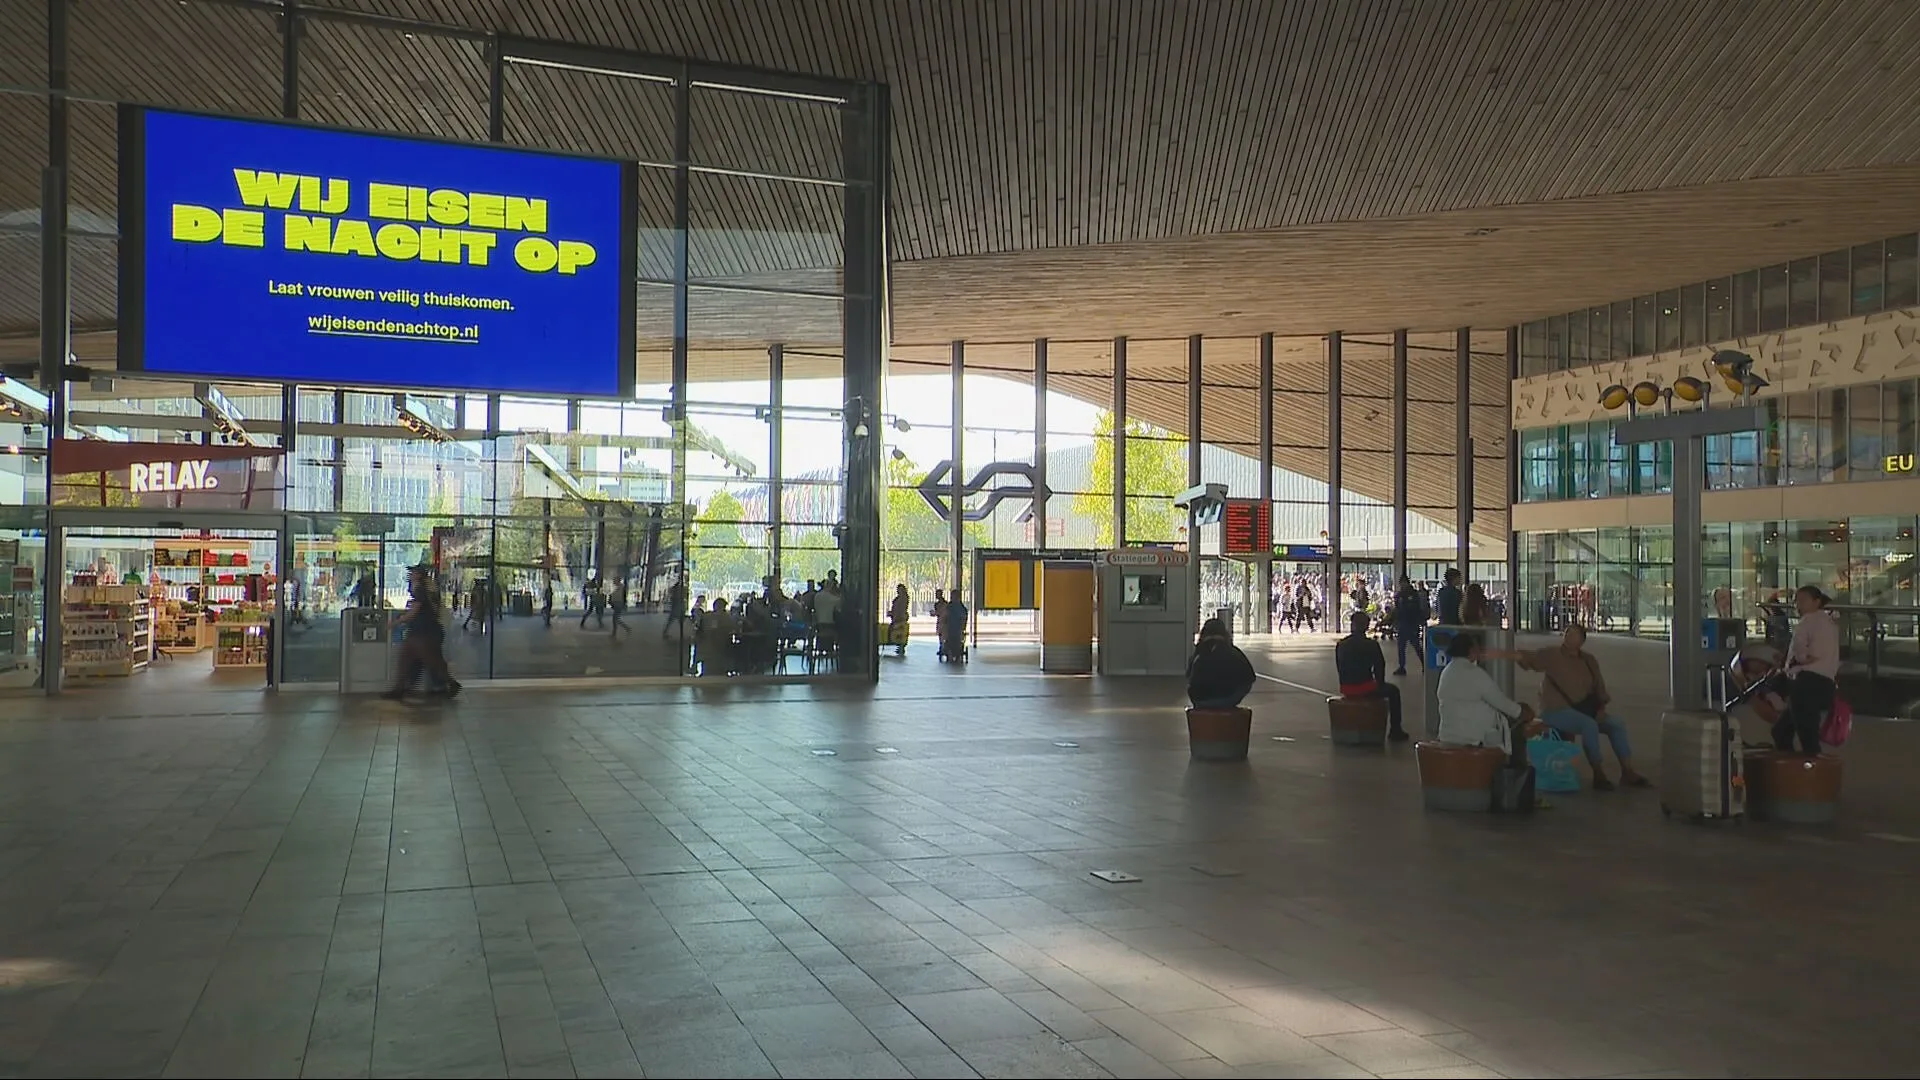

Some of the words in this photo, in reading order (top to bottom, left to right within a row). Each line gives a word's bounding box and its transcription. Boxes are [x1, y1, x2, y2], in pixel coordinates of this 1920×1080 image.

[233, 168, 349, 215] WIJ
[368, 182, 548, 233] EISEN
[171, 203, 265, 248] DE
[284, 213, 497, 266] NACHT
[513, 236, 597, 275] OP
[268, 280, 304, 296] Laat
[307, 285, 375, 301] vrouwen
[378, 289, 420, 308] veilig
[423, 292, 515, 311] thuiskomen.
[308, 314, 479, 341] wijeisendenachtop.nl
[1886, 454, 1914, 472] EU
